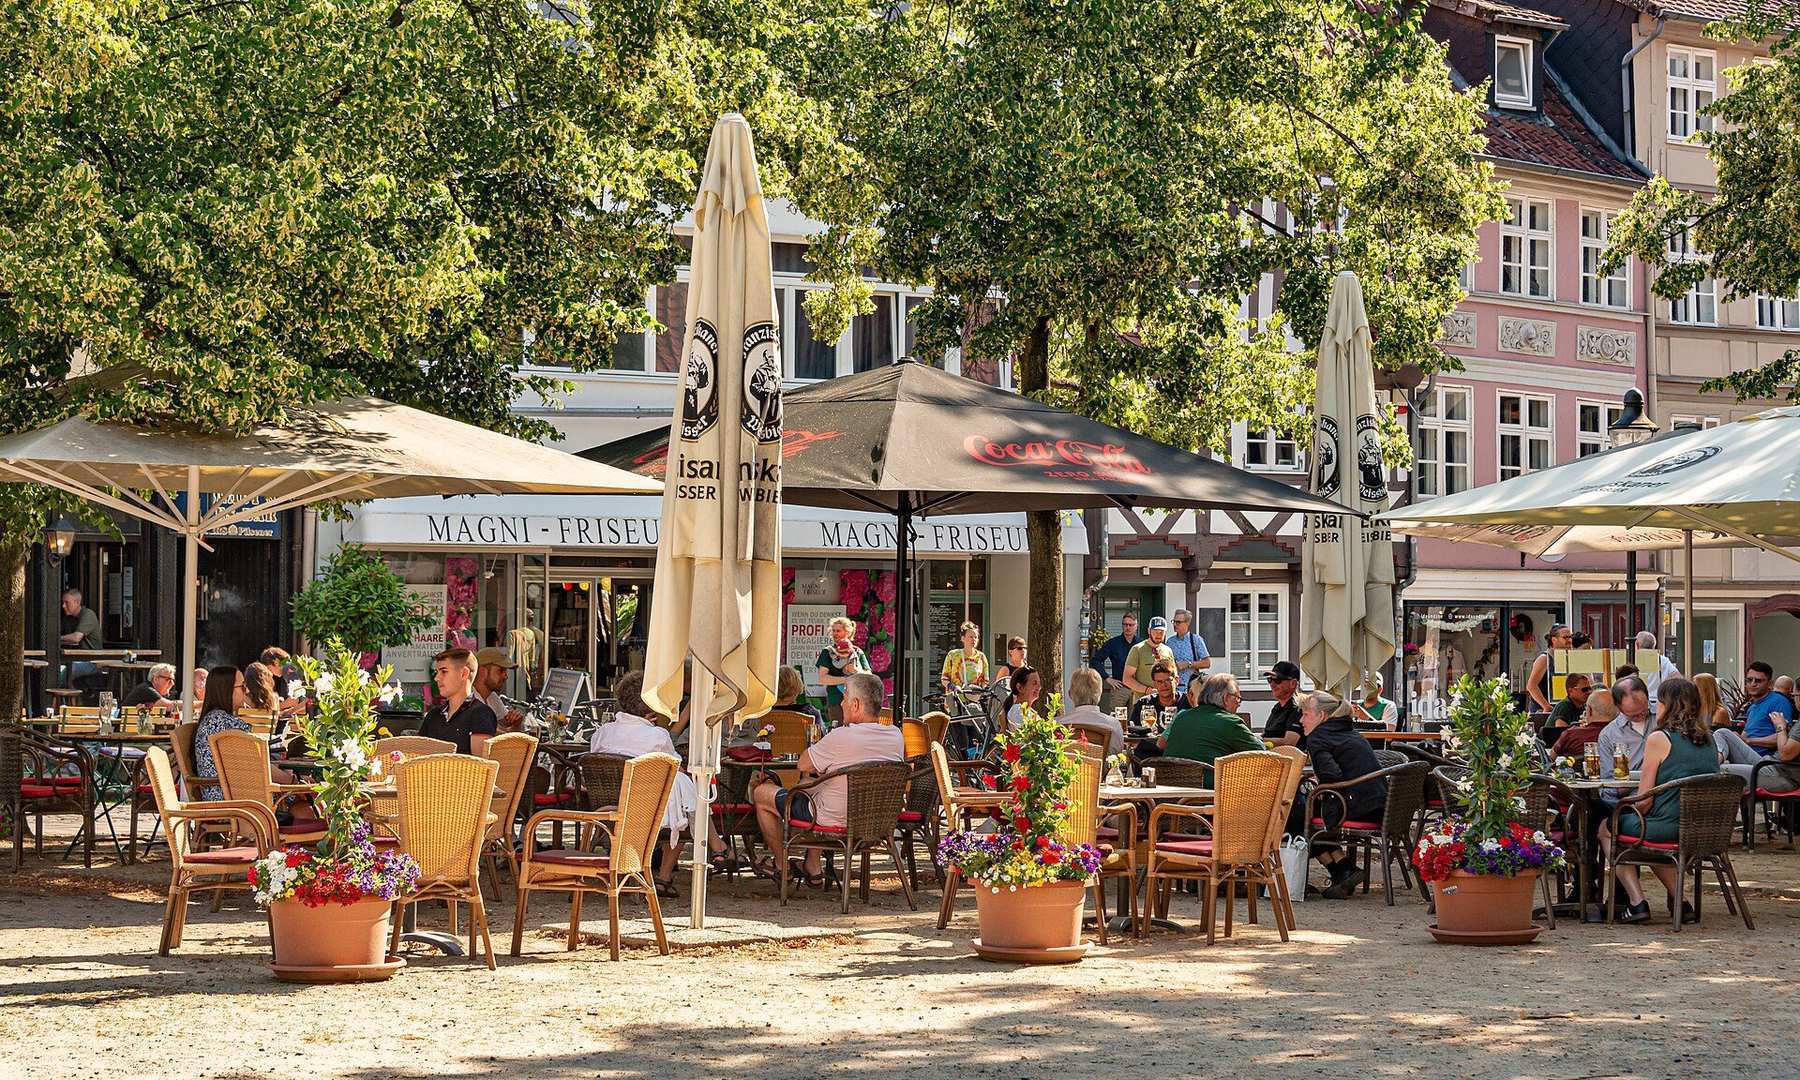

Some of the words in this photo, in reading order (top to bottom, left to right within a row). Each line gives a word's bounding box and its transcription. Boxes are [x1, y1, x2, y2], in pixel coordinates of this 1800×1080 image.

[427, 515, 531, 543] MAGNI
[557, 517, 659, 545] FRISEU
[820, 522, 900, 548] MAGN
[933, 525, 1030, 552] FRISEU
[792, 624, 824, 636] PROFI
[414, 633, 444, 643] HAARE
[385, 650, 441, 658] ANVERTRAUS
